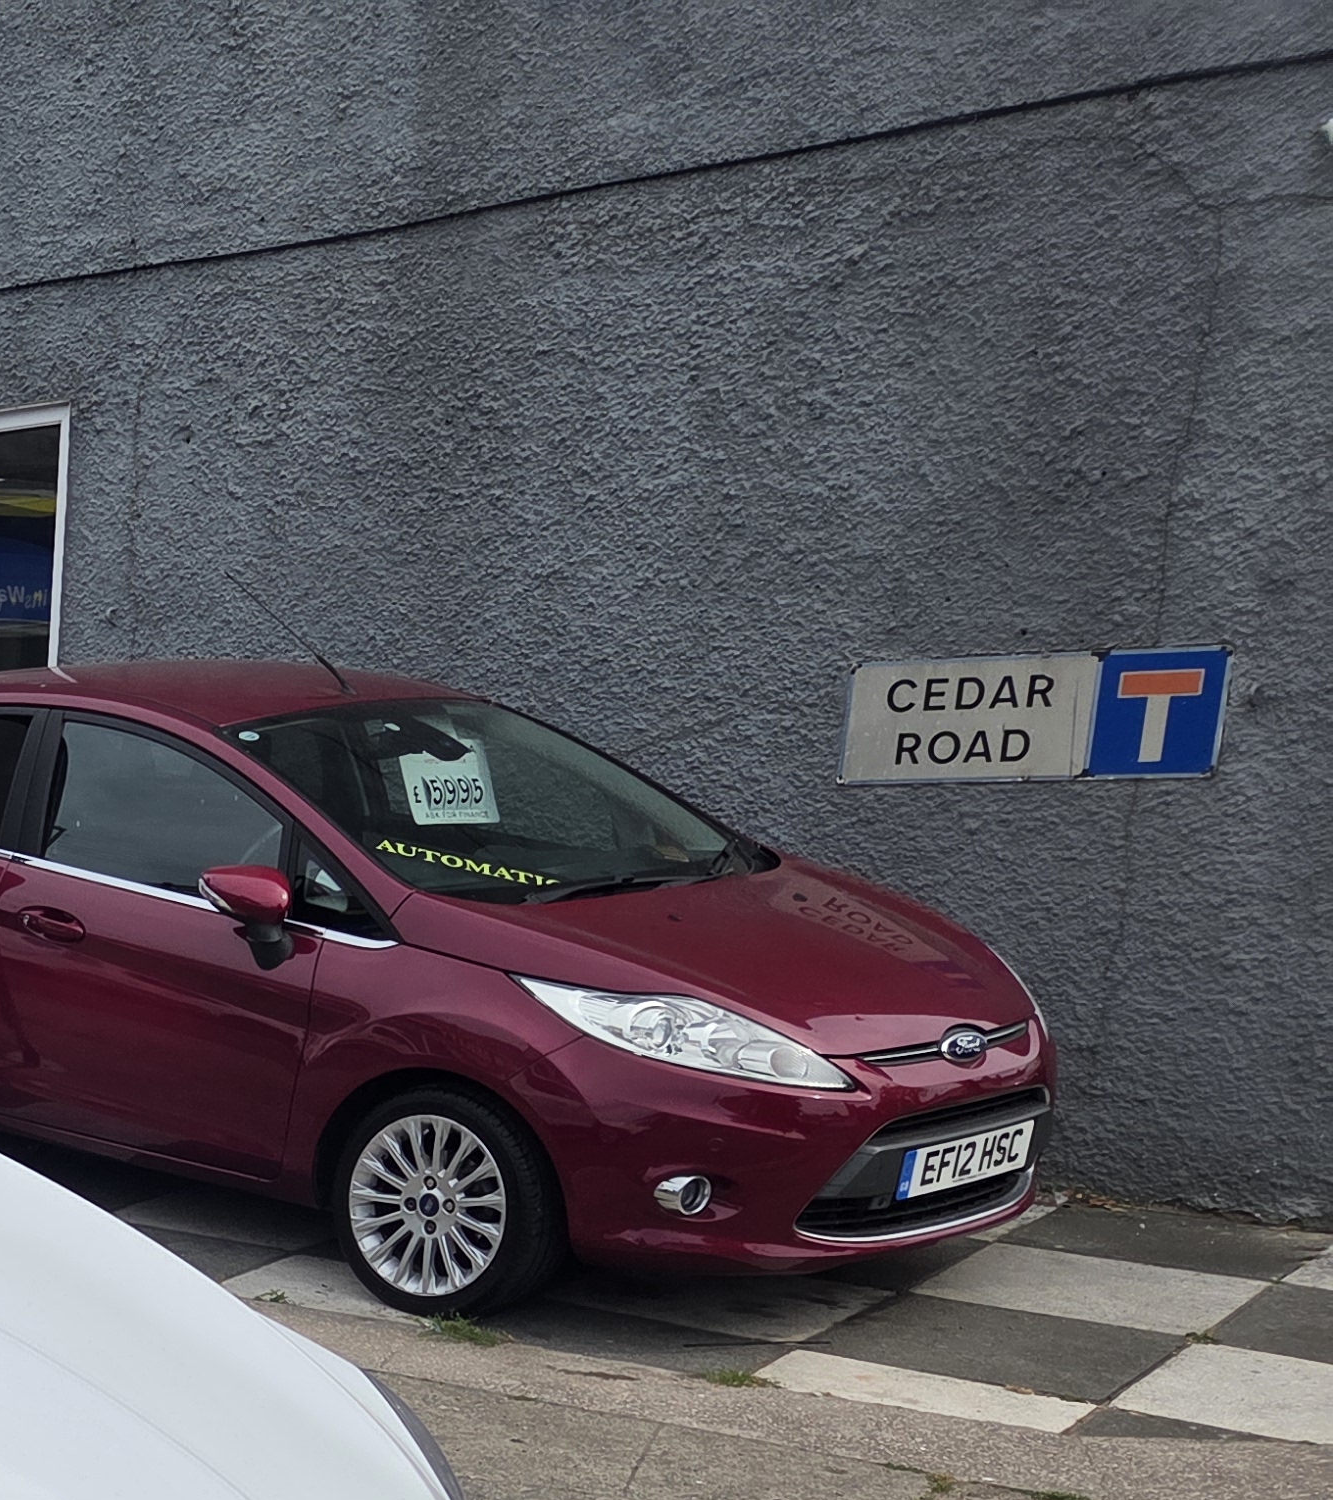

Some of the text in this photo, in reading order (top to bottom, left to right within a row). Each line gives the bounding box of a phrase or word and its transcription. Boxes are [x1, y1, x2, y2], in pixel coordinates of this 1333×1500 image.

[886, 674, 1055, 713] CEDAR
[894, 728, 1031, 765] ROAD
[429, 778, 484, 805] 5995
[920, 1128, 1024, 1186] EF12 HSC
